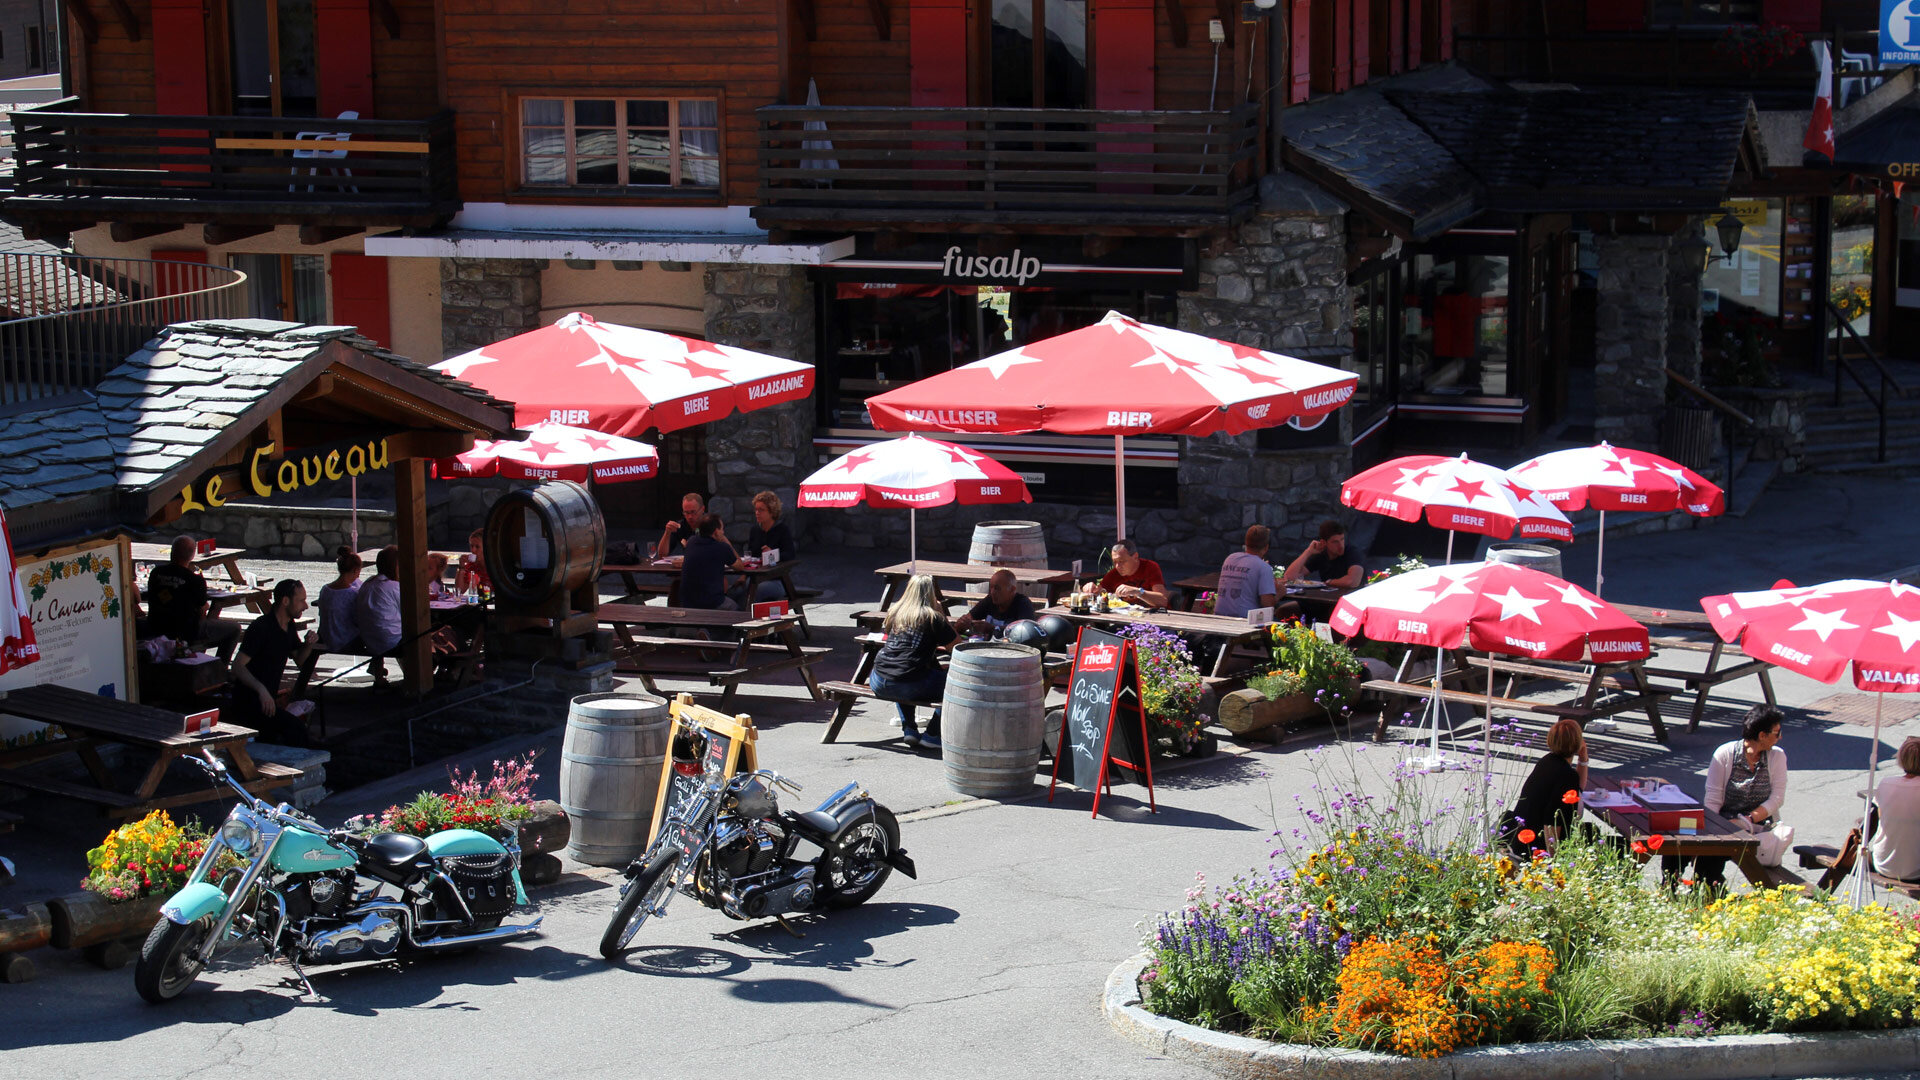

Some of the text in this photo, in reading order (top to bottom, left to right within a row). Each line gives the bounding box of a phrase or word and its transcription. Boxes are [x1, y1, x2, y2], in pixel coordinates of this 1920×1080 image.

[1882, 51, 1920, 61] INFORM
[943, 246, 1041, 286] fusalp
[683, 375, 805, 416] BIERE VALAISANNE
[550, 409, 590, 424] BIER
[905, 409, 1153, 427] WALLISER BIER
[453, 462, 472, 472] BIER
[524, 464, 650, 479] BIERE VALAISANNE
[181, 438, 389, 515] Le Caveau
[881, 486, 1001, 502] WALLISER BIER
[1620, 493, 1647, 504] BIER
[1376, 498, 1485, 527] BIER BIERE
[48, 598, 95, 621] Caveau
[1397, 619, 1428, 635] BIER
[1504, 635, 1643, 653] BIERE VALAISANNE
[1084, 649, 1113, 665] rivella
[1770, 642, 1920, 685] BIERE VALAIS
